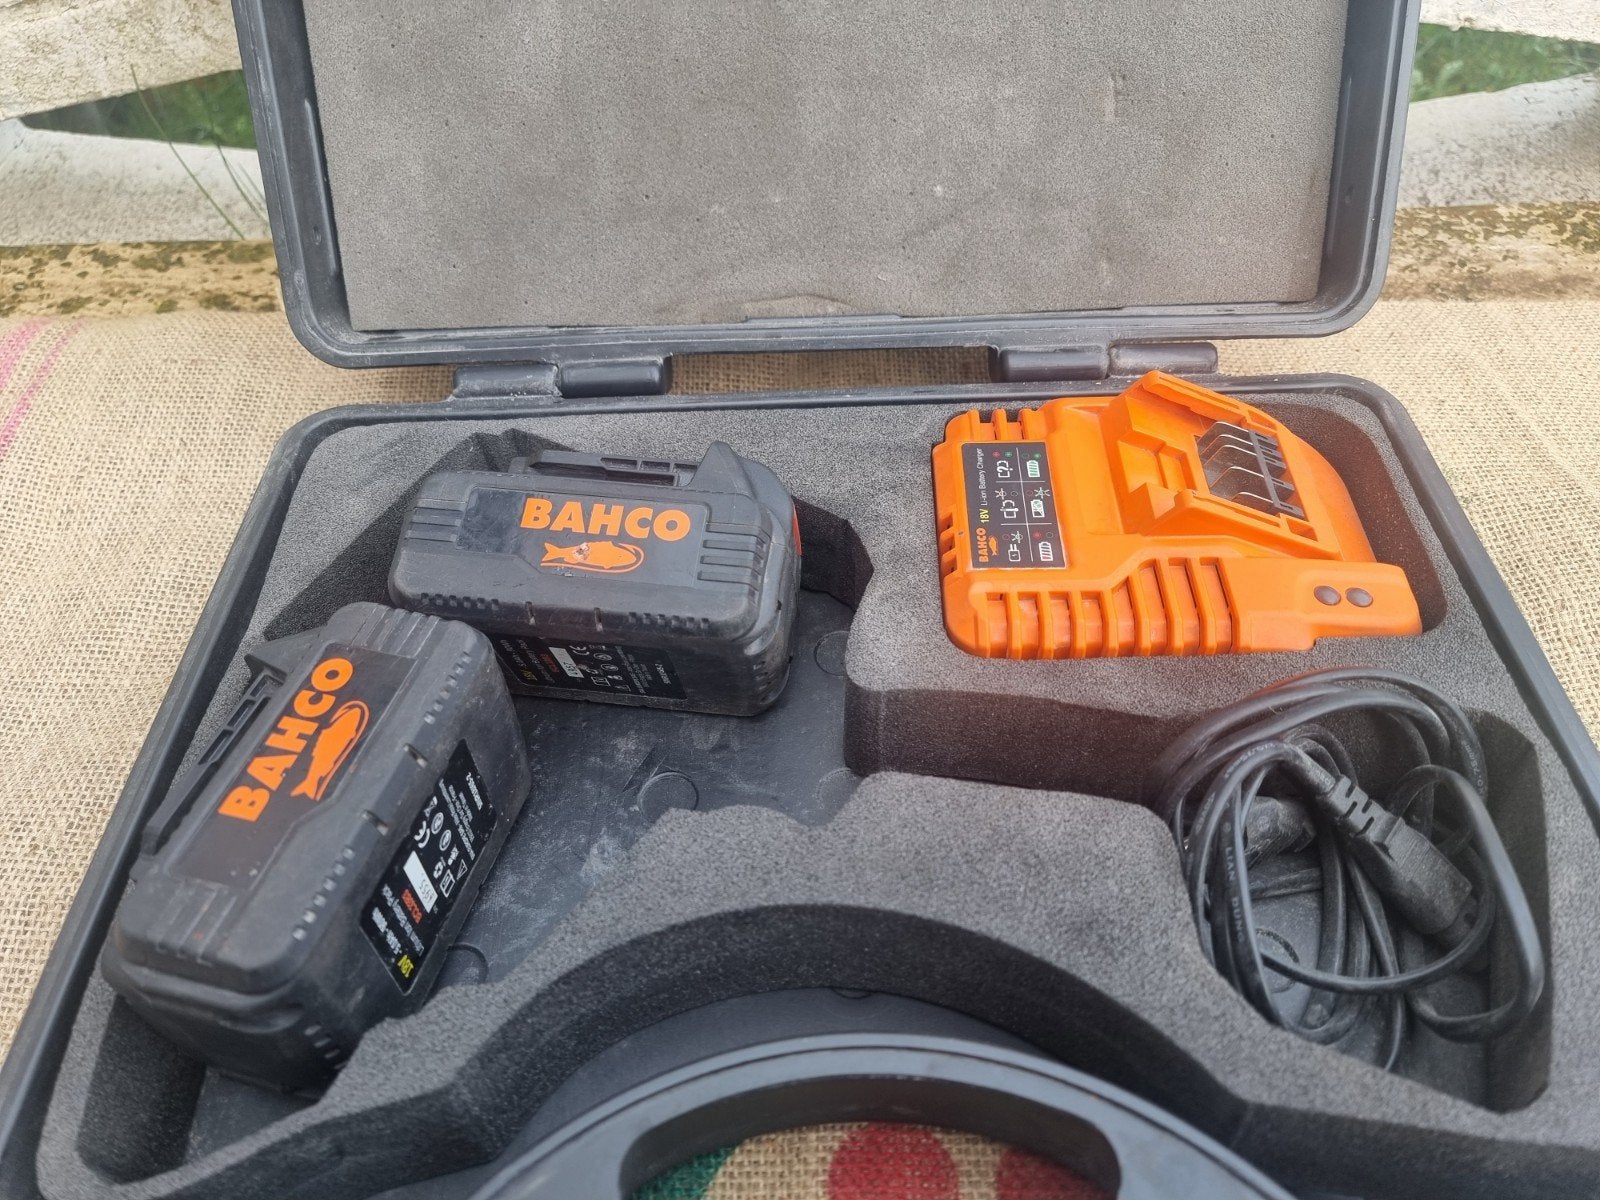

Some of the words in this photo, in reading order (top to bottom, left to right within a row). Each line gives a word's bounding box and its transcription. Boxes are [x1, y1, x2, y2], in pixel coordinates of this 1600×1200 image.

[976, 448, 985, 469] Charger
[520, 497, 691, 542] BAHCO
[980, 508, 989, 523] 18V
[976, 528, 988, 563] BAHCO
[218, 658, 354, 821] BAHCO
[398, 955, 413, 978] 18V
